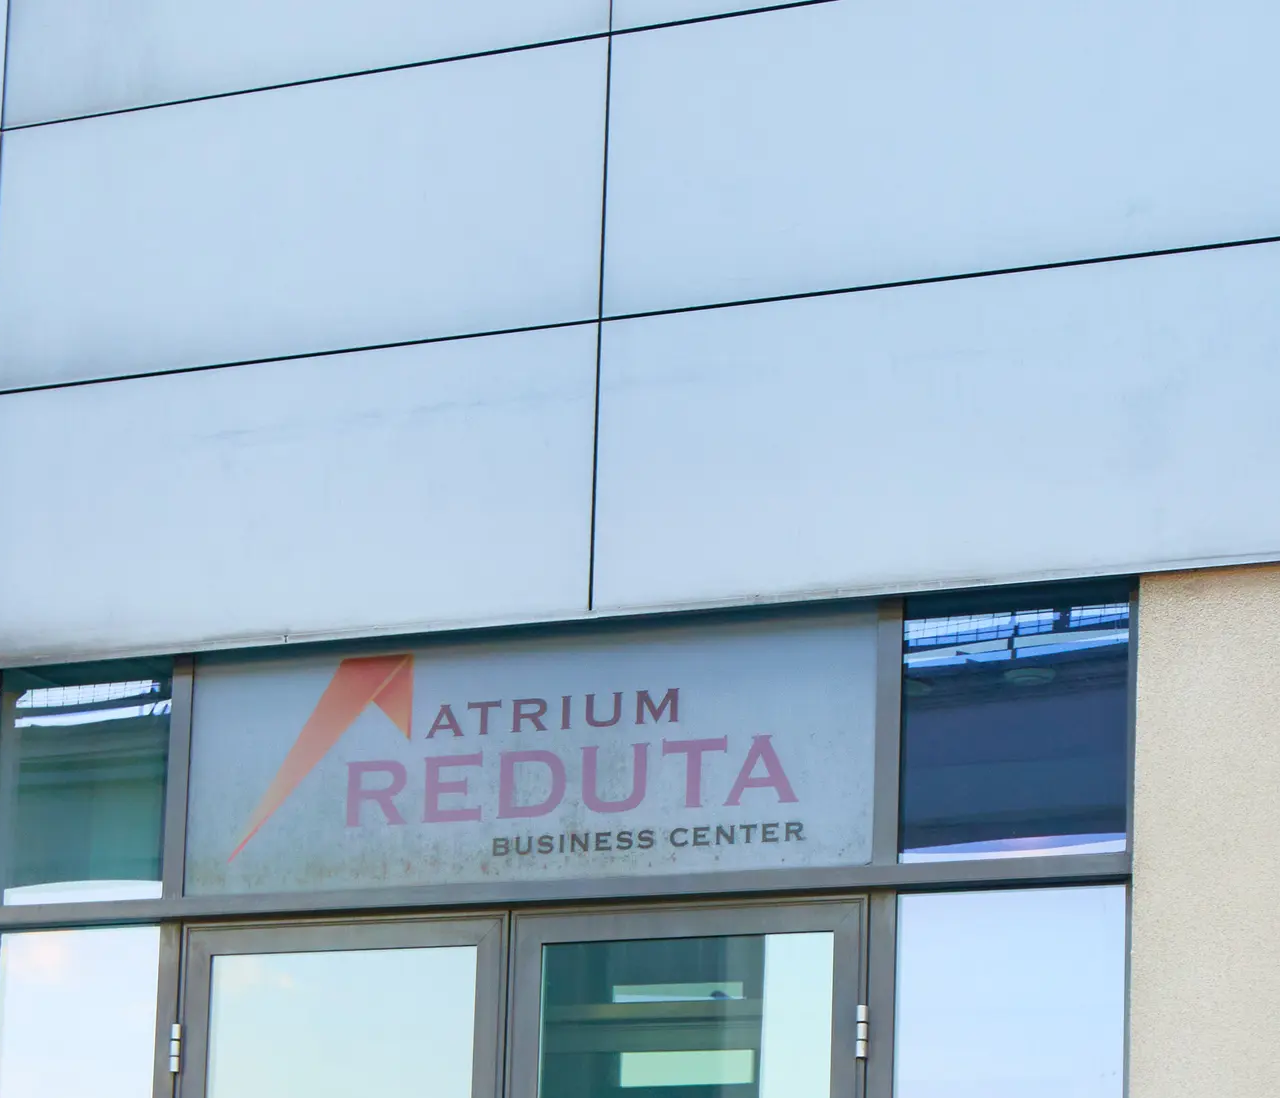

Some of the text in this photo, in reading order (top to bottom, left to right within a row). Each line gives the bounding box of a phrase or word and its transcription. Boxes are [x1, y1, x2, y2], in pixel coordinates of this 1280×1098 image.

[425, 687, 680, 739] ATRIUM
[343, 734, 800, 829] REDUTA
[491, 821, 807, 857] BUSINESS CENTER
